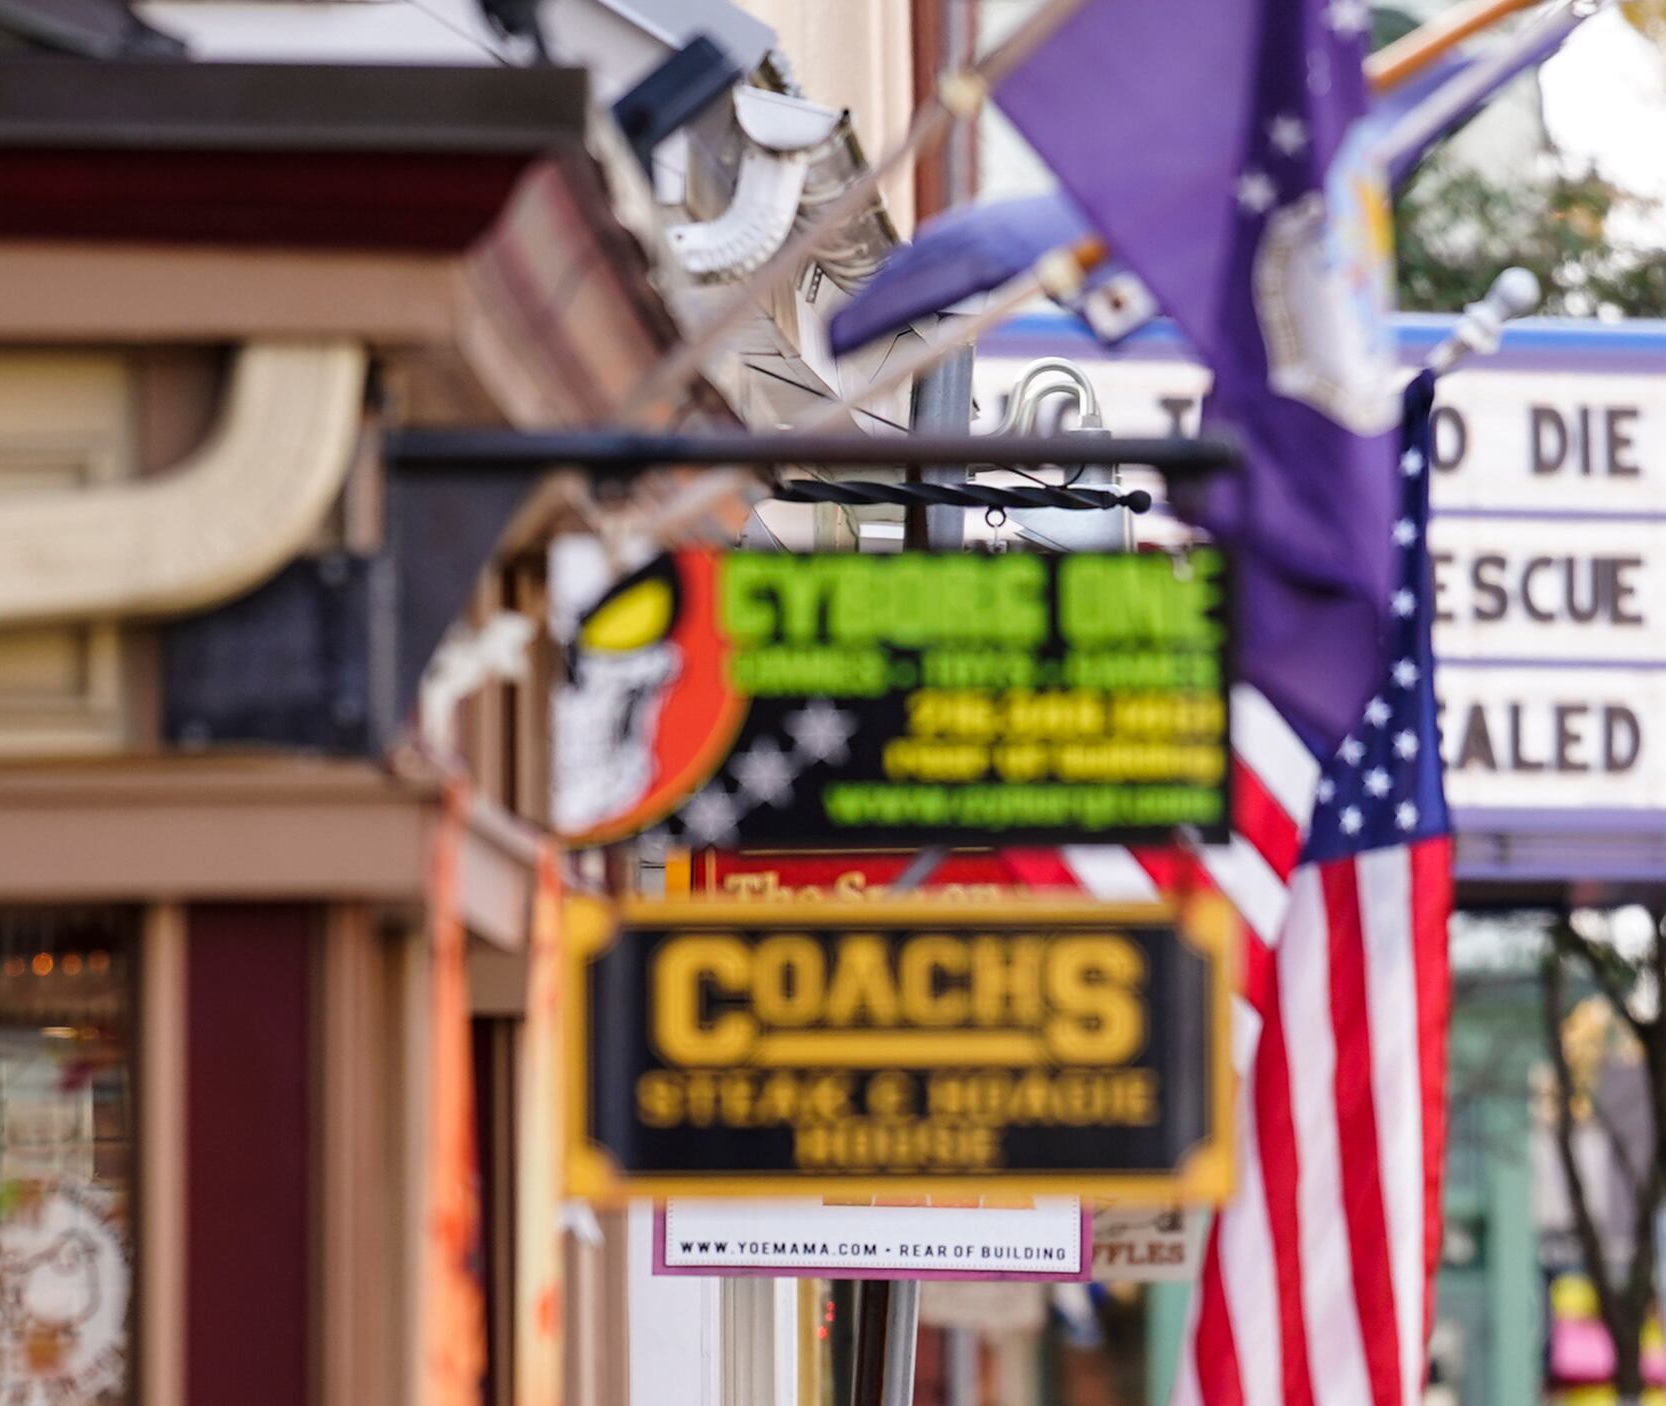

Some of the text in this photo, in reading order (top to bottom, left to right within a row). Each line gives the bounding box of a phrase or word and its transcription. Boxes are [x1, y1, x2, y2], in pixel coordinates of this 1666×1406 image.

[1532, 406, 1642, 476] DIE
[651, 933, 1145, 1068] COACHS
[680, 1240, 1066, 1262] WWW.YOEMAMA.COM REAR OF BUILDING
